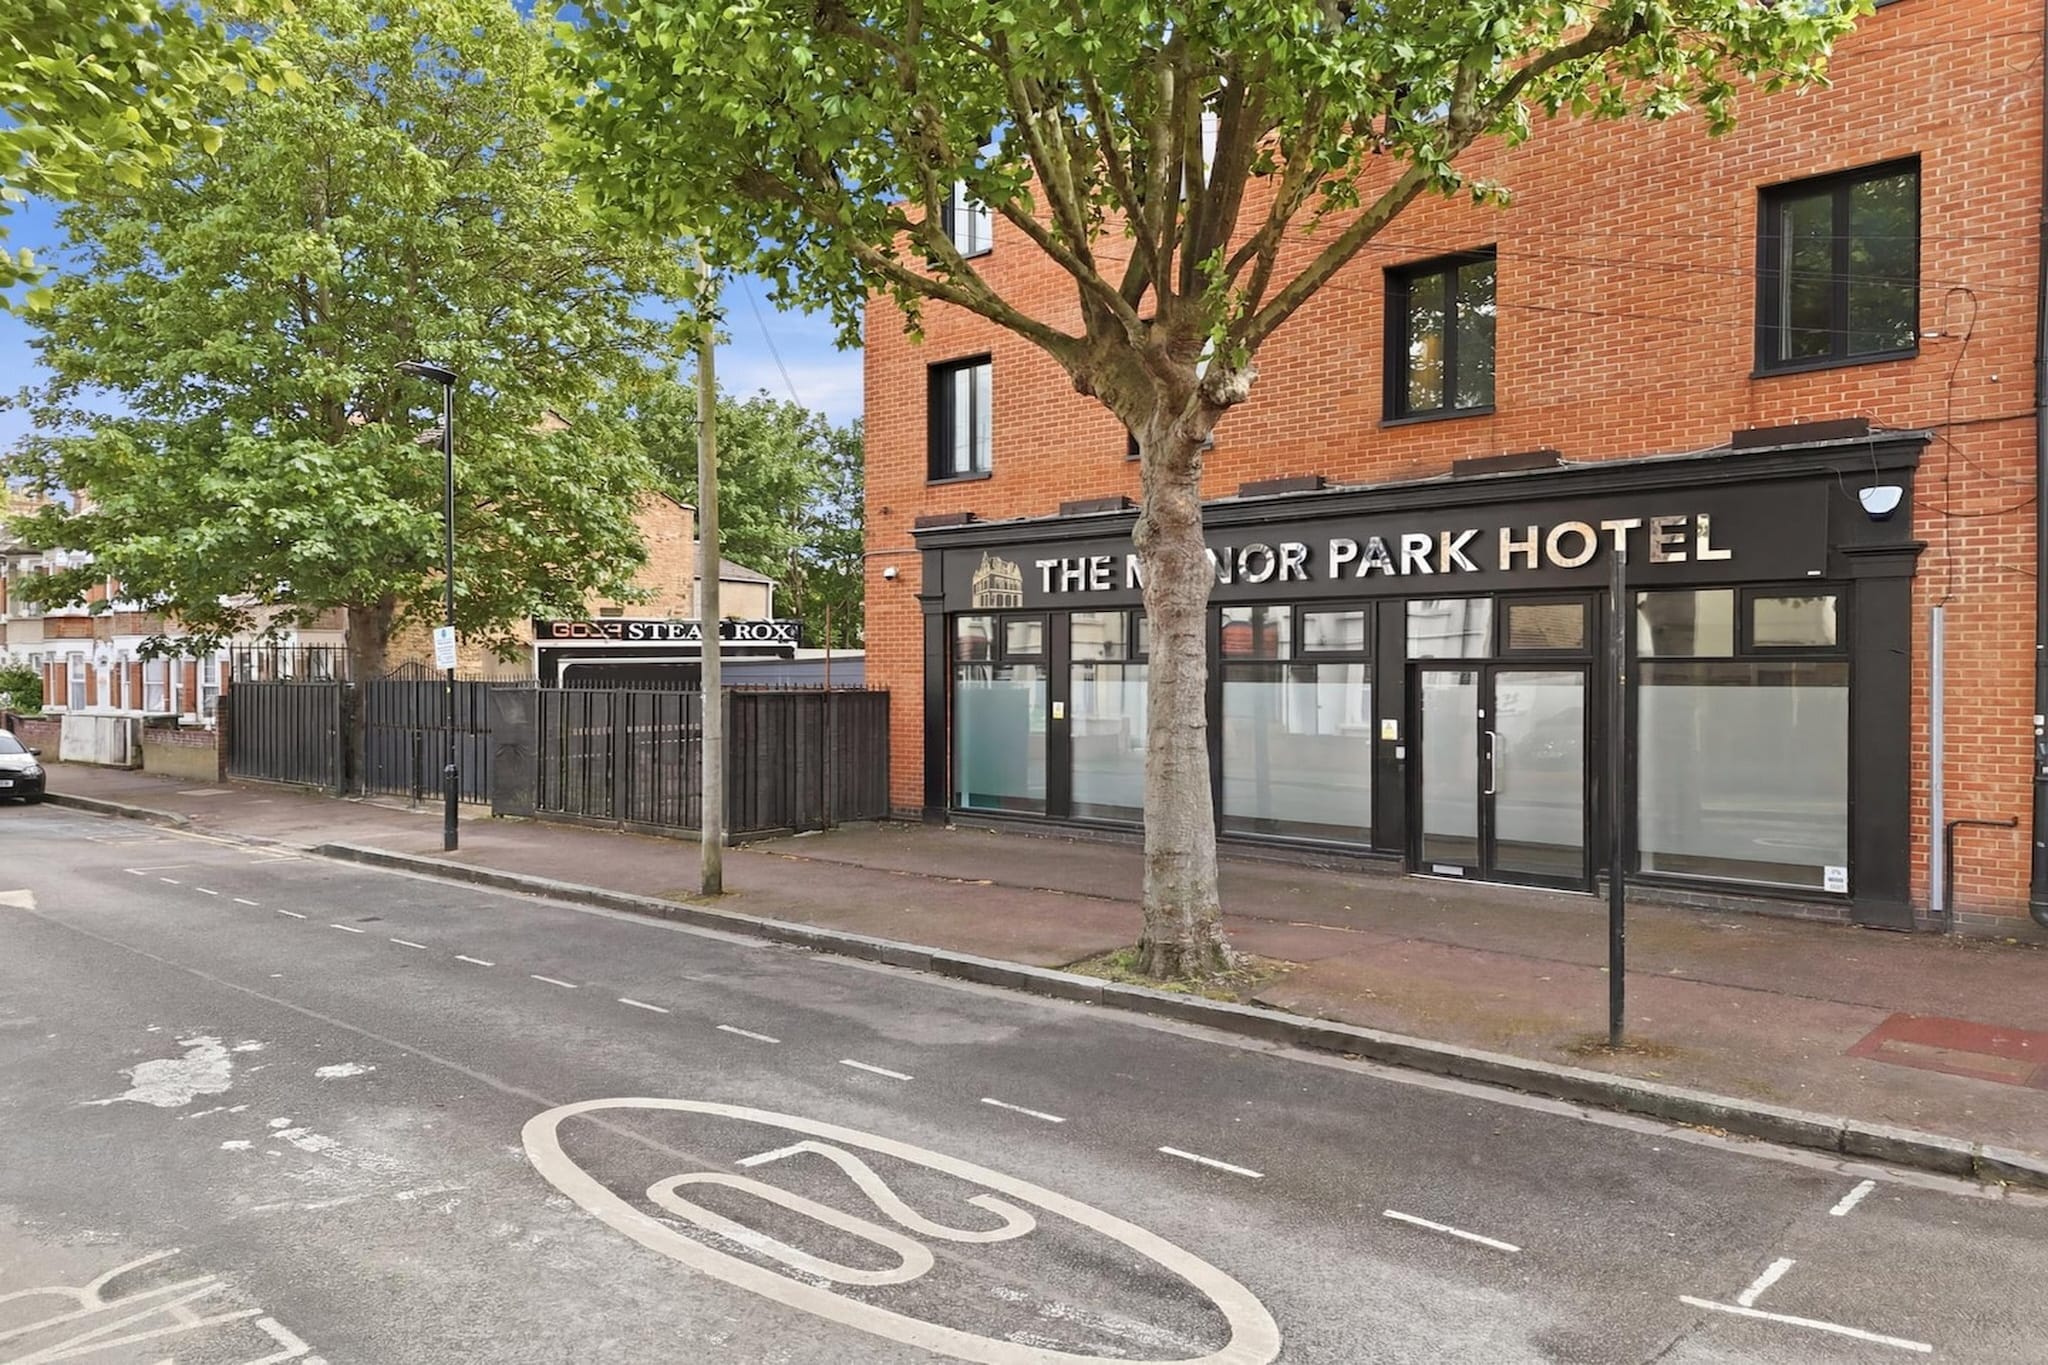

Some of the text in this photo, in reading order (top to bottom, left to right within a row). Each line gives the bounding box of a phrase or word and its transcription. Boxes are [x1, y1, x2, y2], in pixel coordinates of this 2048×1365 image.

[1035, 513, 1732, 593] THE NOR PARK HOTEL
[733, 624, 795, 640] ROX
[646, 1140, 1037, 1286] 20
